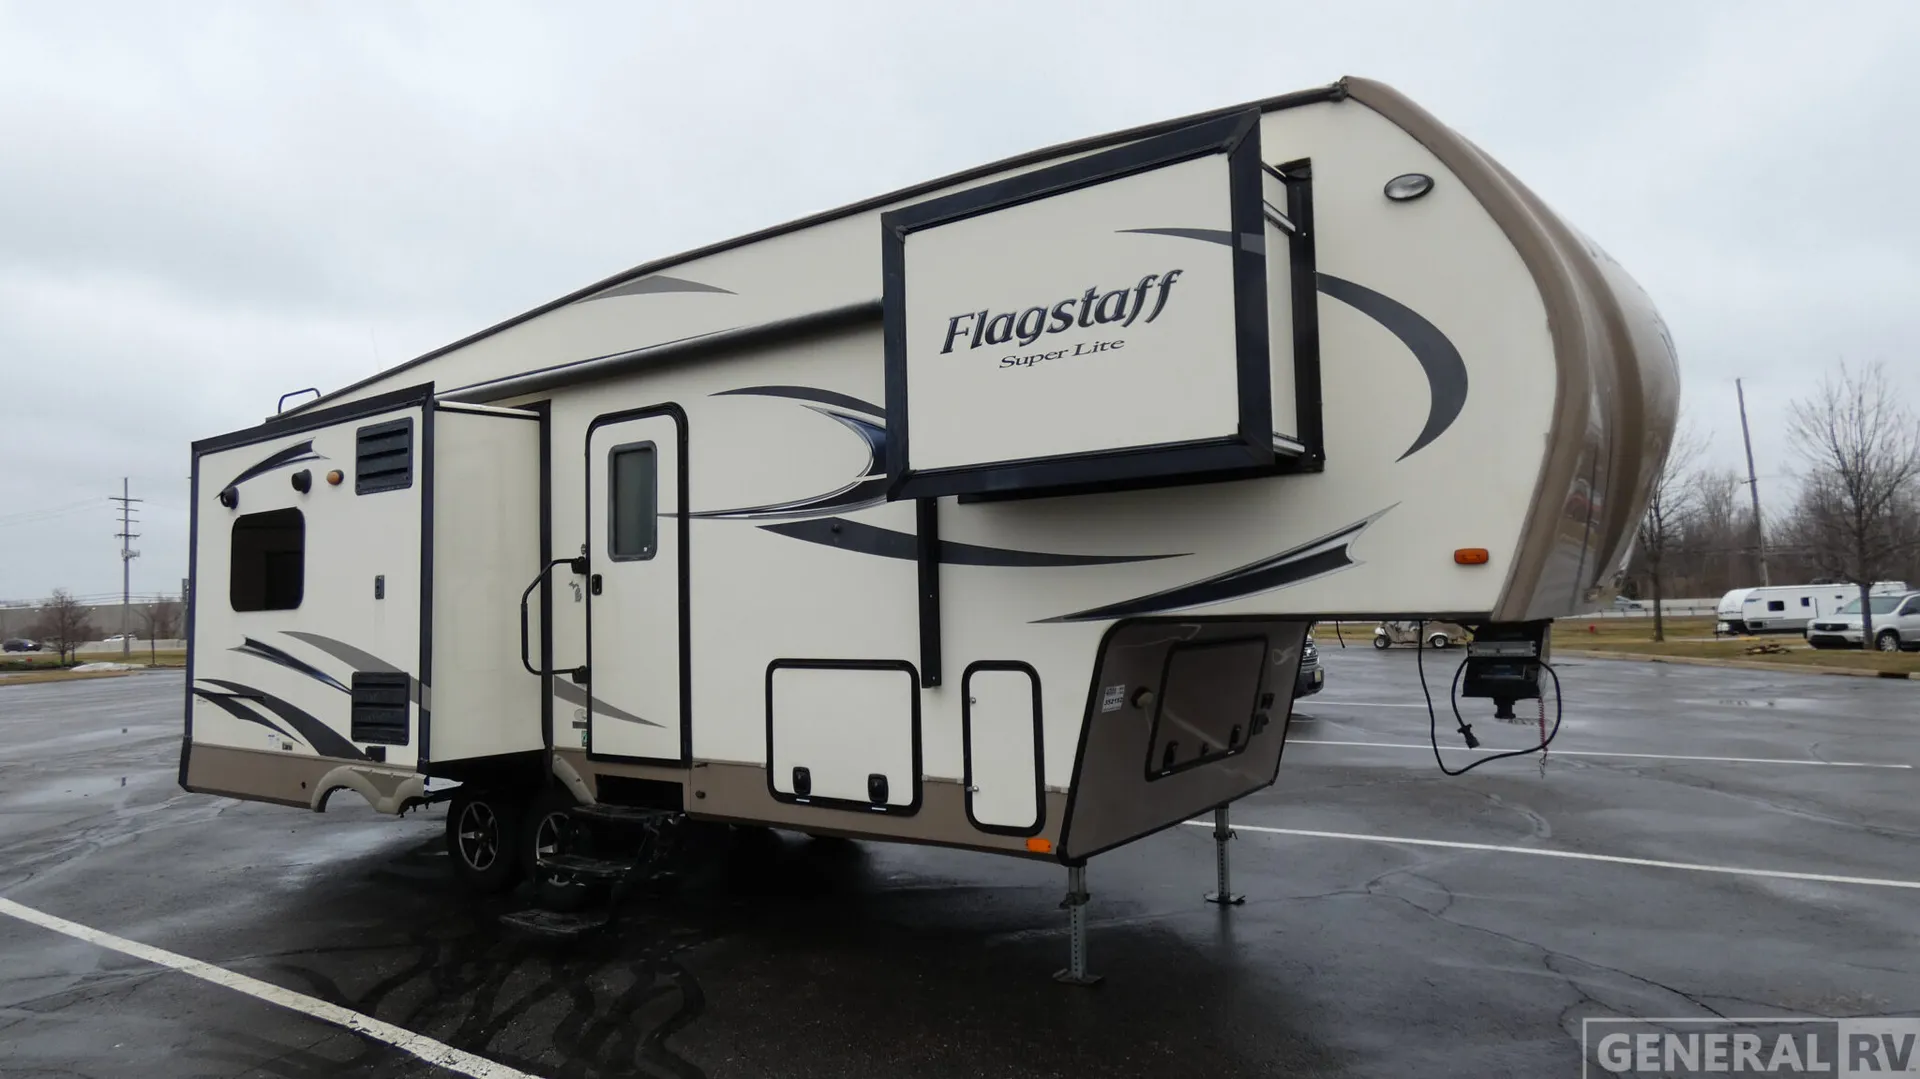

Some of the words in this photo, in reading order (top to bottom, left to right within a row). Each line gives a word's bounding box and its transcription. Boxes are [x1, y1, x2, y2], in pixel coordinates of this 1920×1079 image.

[940, 269, 1184, 354] Flagstaff
[998, 348, 1069, 369] Super
[1072, 338, 1125, 356] Lite
